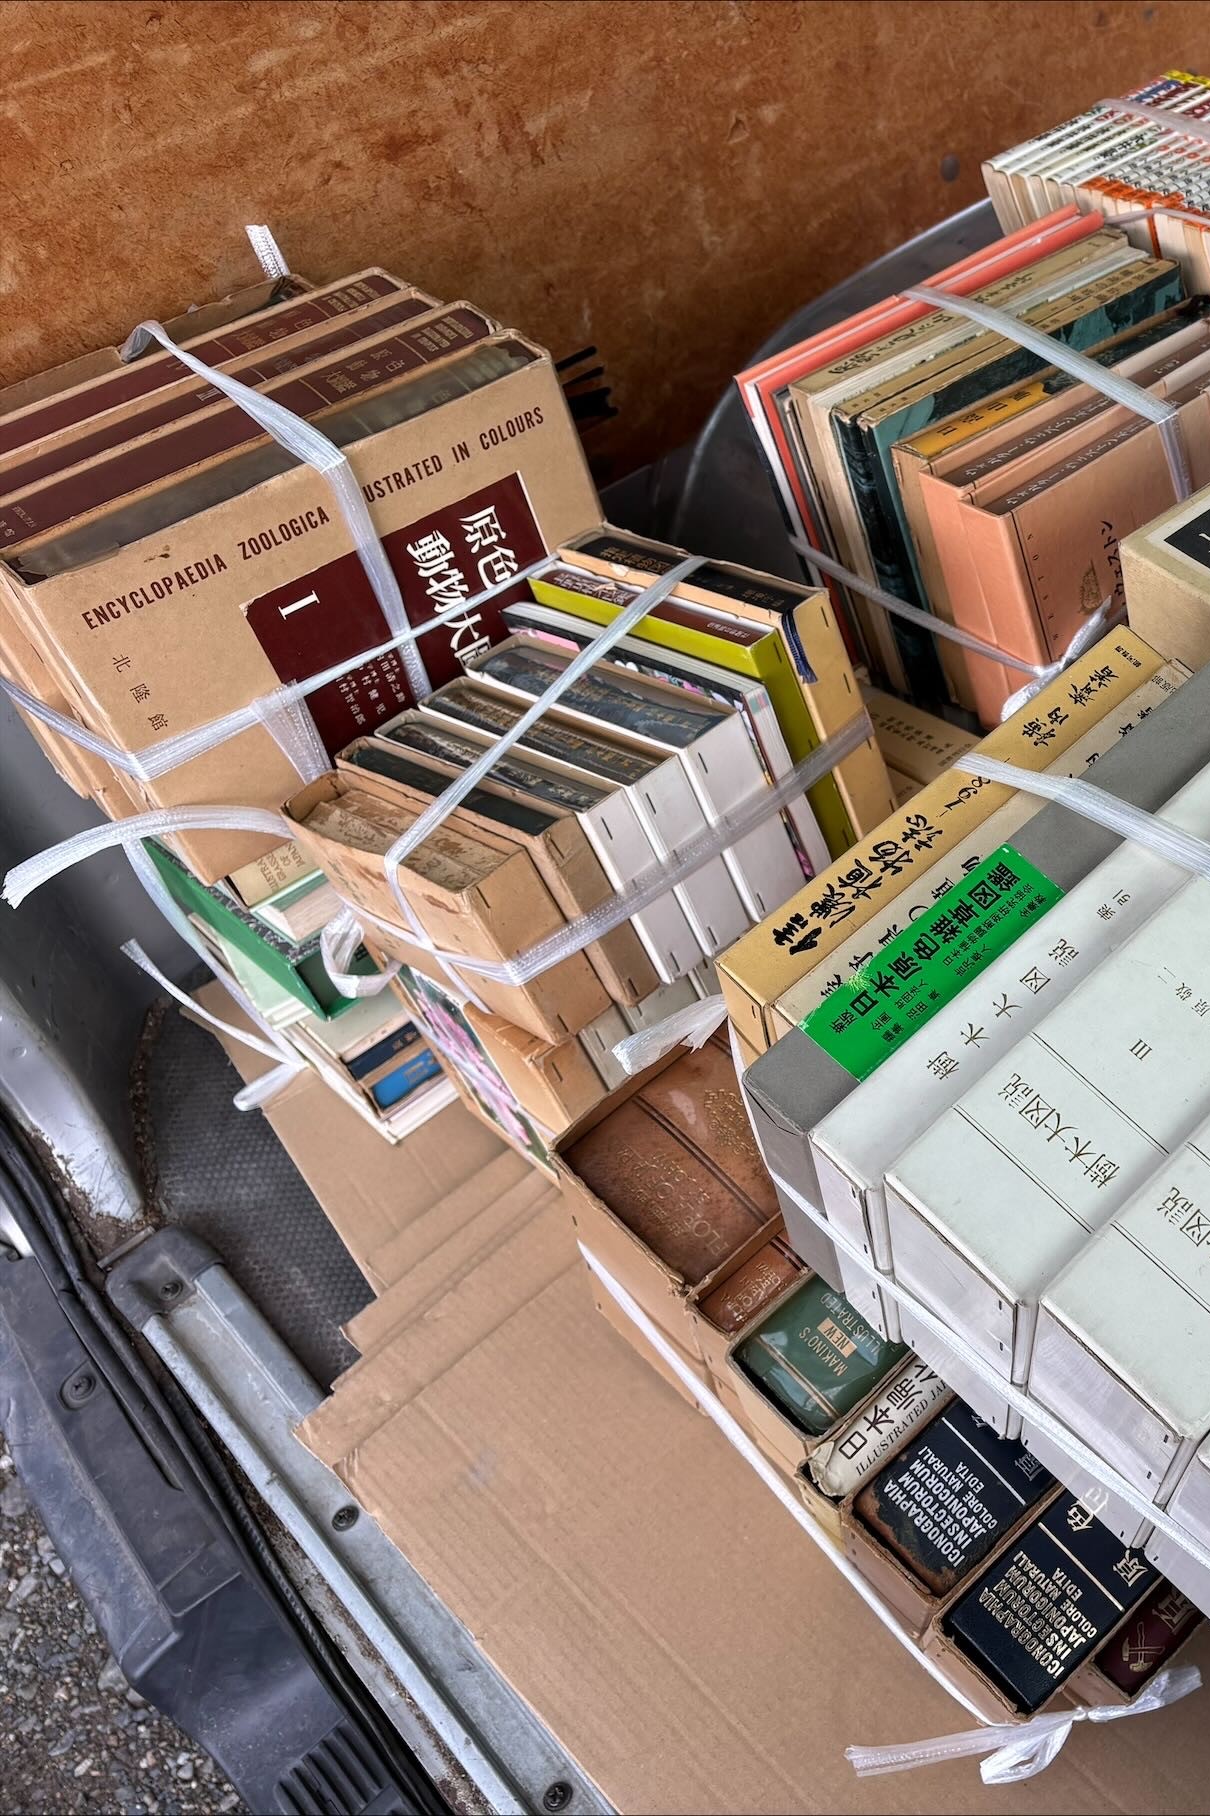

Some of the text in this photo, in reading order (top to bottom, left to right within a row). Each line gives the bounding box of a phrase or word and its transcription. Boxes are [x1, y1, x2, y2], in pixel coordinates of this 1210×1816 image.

[81, 406, 545, 630] ENCYCLOPAEDIA ZOOLOGICA USTRATED IN COLOURS
[459, 505, 518, 590] 原色
[112, 654, 169, 731] 北隆館
[771, 814, 944, 957] 信濃植物誌
[1096, 888, 1131, 921] 索引
[830, 861, 1020, 1036] 新版 日本原色雑草図鑑
[998, 1072, 1121, 1190] 樹木大図説
[798, 1327, 848, 1377] MAKINO'S
[823, 1326, 847, 1351] NEW
[855, 1402, 929, 1477] ILLUSTRATED
[956, 1462, 985, 1492] EDITA
[884, 1479, 965, 1568] ICONOGRAPHIA
[899, 1471, 974, 1550] INSECTORUM
[910, 1460, 988, 1540] JAPONICORUM
[919, 1446, 998, 1529] COLORE NATURALI
[994, 1579, 1073, 1662] INSECTORUM
[1004, 1565, 1086, 1650] JAPONICORUM
[1013, 1551, 1096, 1638] COLORE NATURALI
[1050, 1568, 1083, 1601] EDITA
[978, 1587, 1065, 1680] ICONOGRAPHIA
